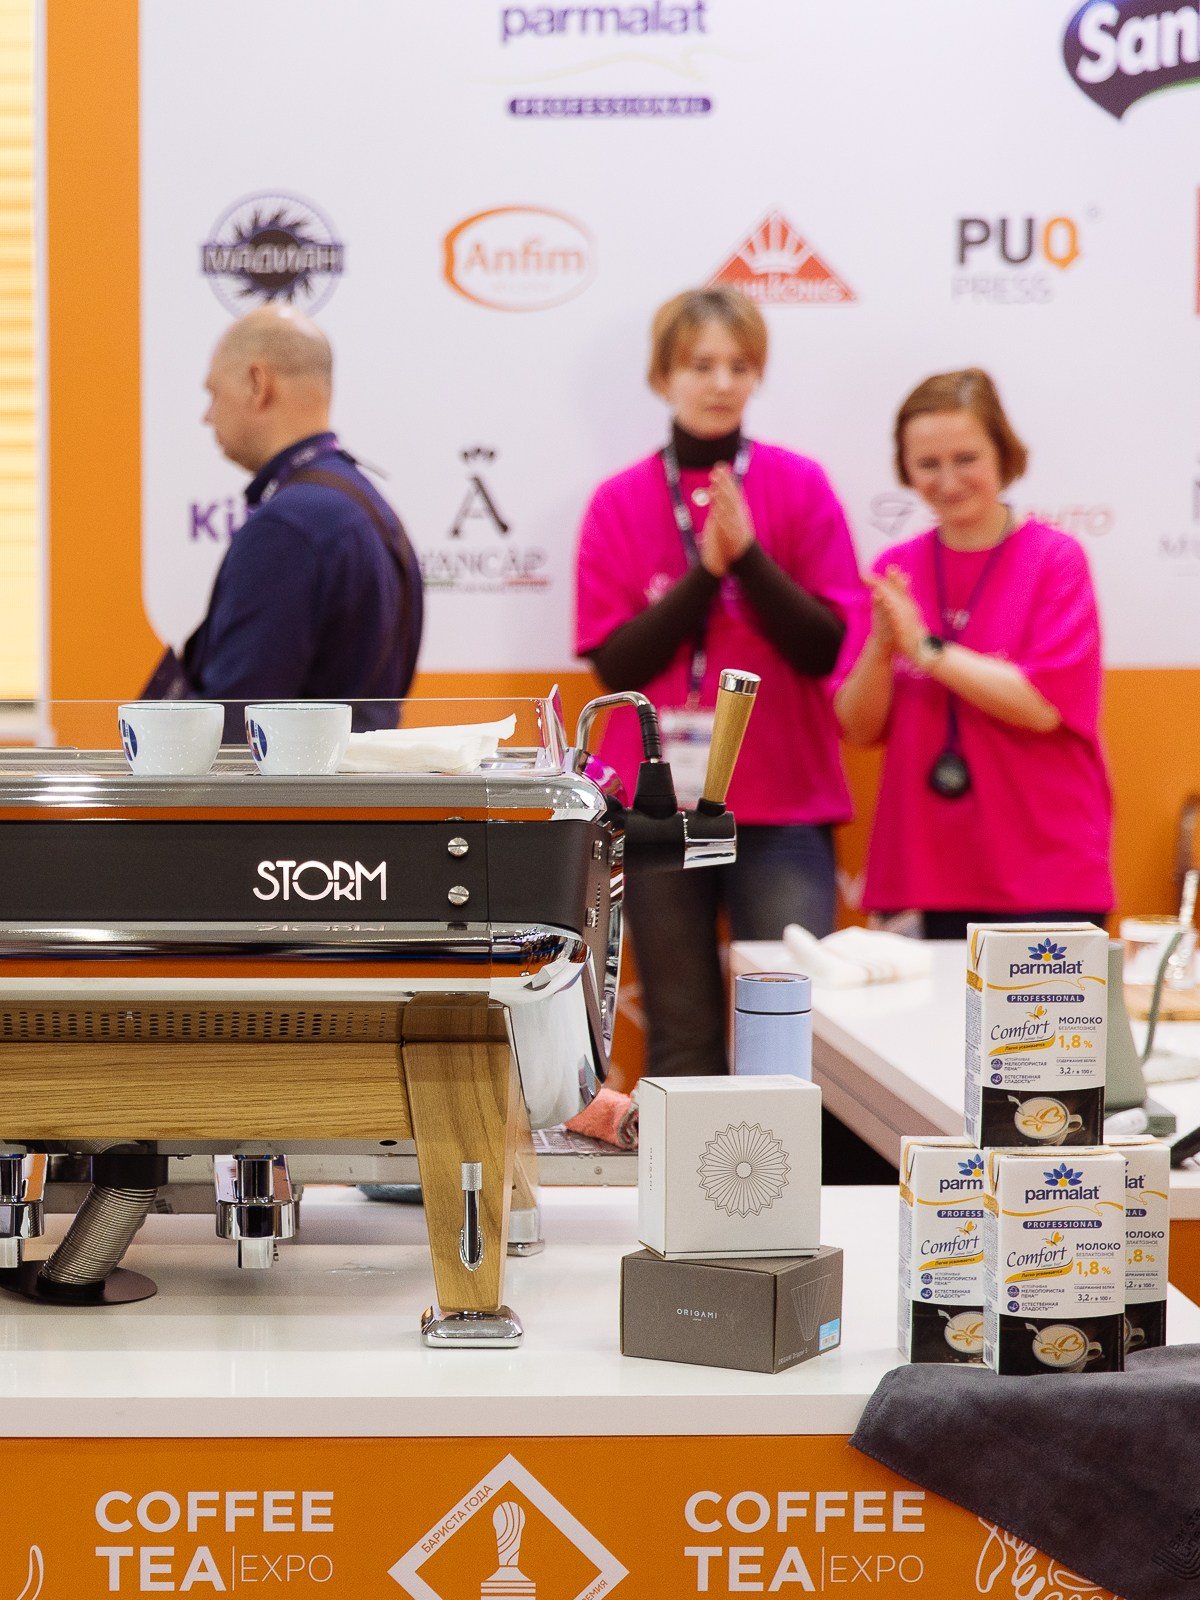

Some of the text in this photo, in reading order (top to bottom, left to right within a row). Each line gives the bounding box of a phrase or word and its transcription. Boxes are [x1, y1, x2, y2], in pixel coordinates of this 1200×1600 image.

[502, 1, 709, 43] parmalat
[1076, 0, 1200, 84] San
[956, 217, 1081, 269] PUQ
[464, 236, 586, 276] Anfim
[953, 277, 1052, 303] PRESS
[252, 860, 387, 901] STORM
[1009, 960, 1083, 977] parmalat
[990, 1020, 1051, 1041] Comfort
[1058, 1016, 1103, 1025] МОЛОКО
[1058, 1034, 1093, 1051] 1,8 %
[1059, 1067, 1071, 1075] 3,2
[939, 1178, 984, 1194] parm
[1125, 1175, 1145, 1189] lat
[1025, 1186, 1100, 1204] parmalat
[920, 1235, 980, 1255] Comfort
[1076, 1242, 1121, 1251] МОЛОКО
[1006, 1247, 1068, 1268] Comfort
[1127, 1249, 1155, 1264] ,8 %
[1076, 1260, 1111, 1277] 1,8 %
[1077, 1294, 1090, 1302] 3,2
[676, 1308, 718, 1319] ORIGAMI
[95, 1490, 334, 1533] COFFEE
[421, 1484, 493, 1553] БАРИСТА ГОДА
[684, 1490, 926, 1533] COFFEE
[95, 1546, 334, 1592] TEA EXPO
[684, 1547, 925, 1592] TEA EXPO
